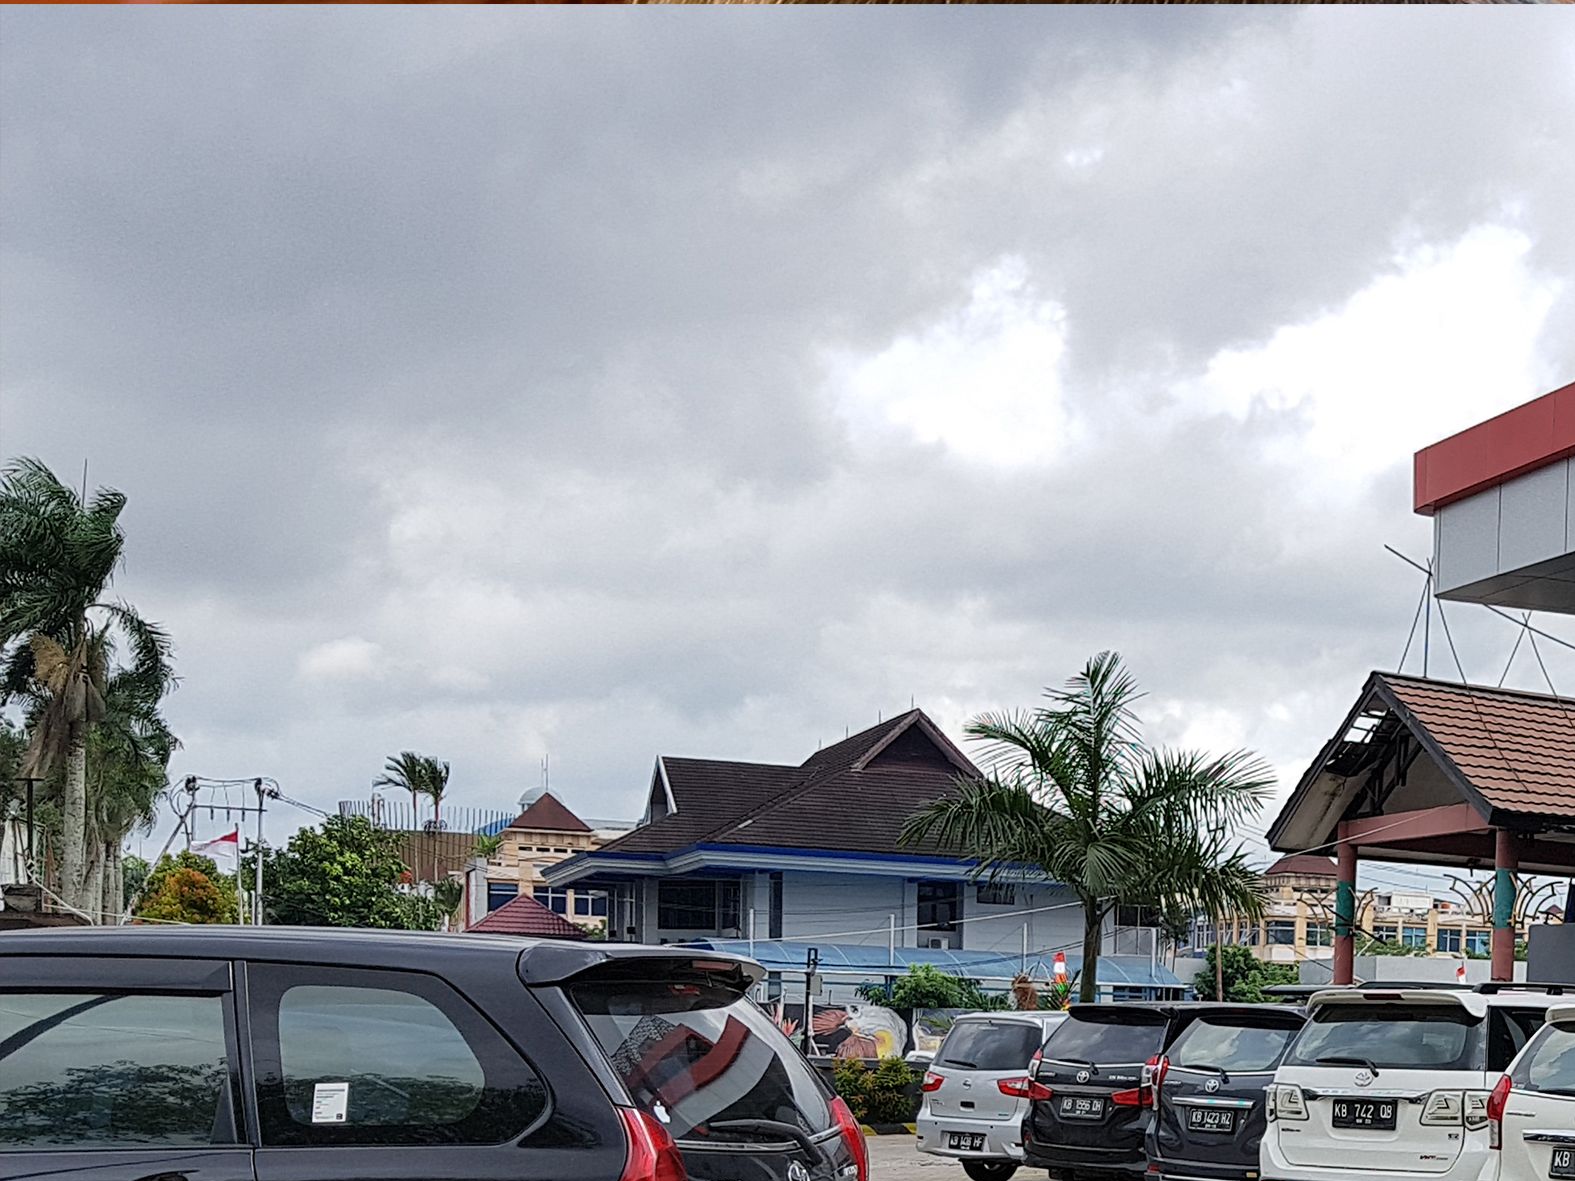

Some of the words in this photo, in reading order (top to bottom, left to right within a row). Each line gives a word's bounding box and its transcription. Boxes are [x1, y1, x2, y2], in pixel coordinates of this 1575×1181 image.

[1192, 1111, 1202, 1123] KB
[1334, 1103, 1347, 1118] KB
[1354, 1103, 1374, 1119] 742
[1554, 1151, 1570, 1167] KB
